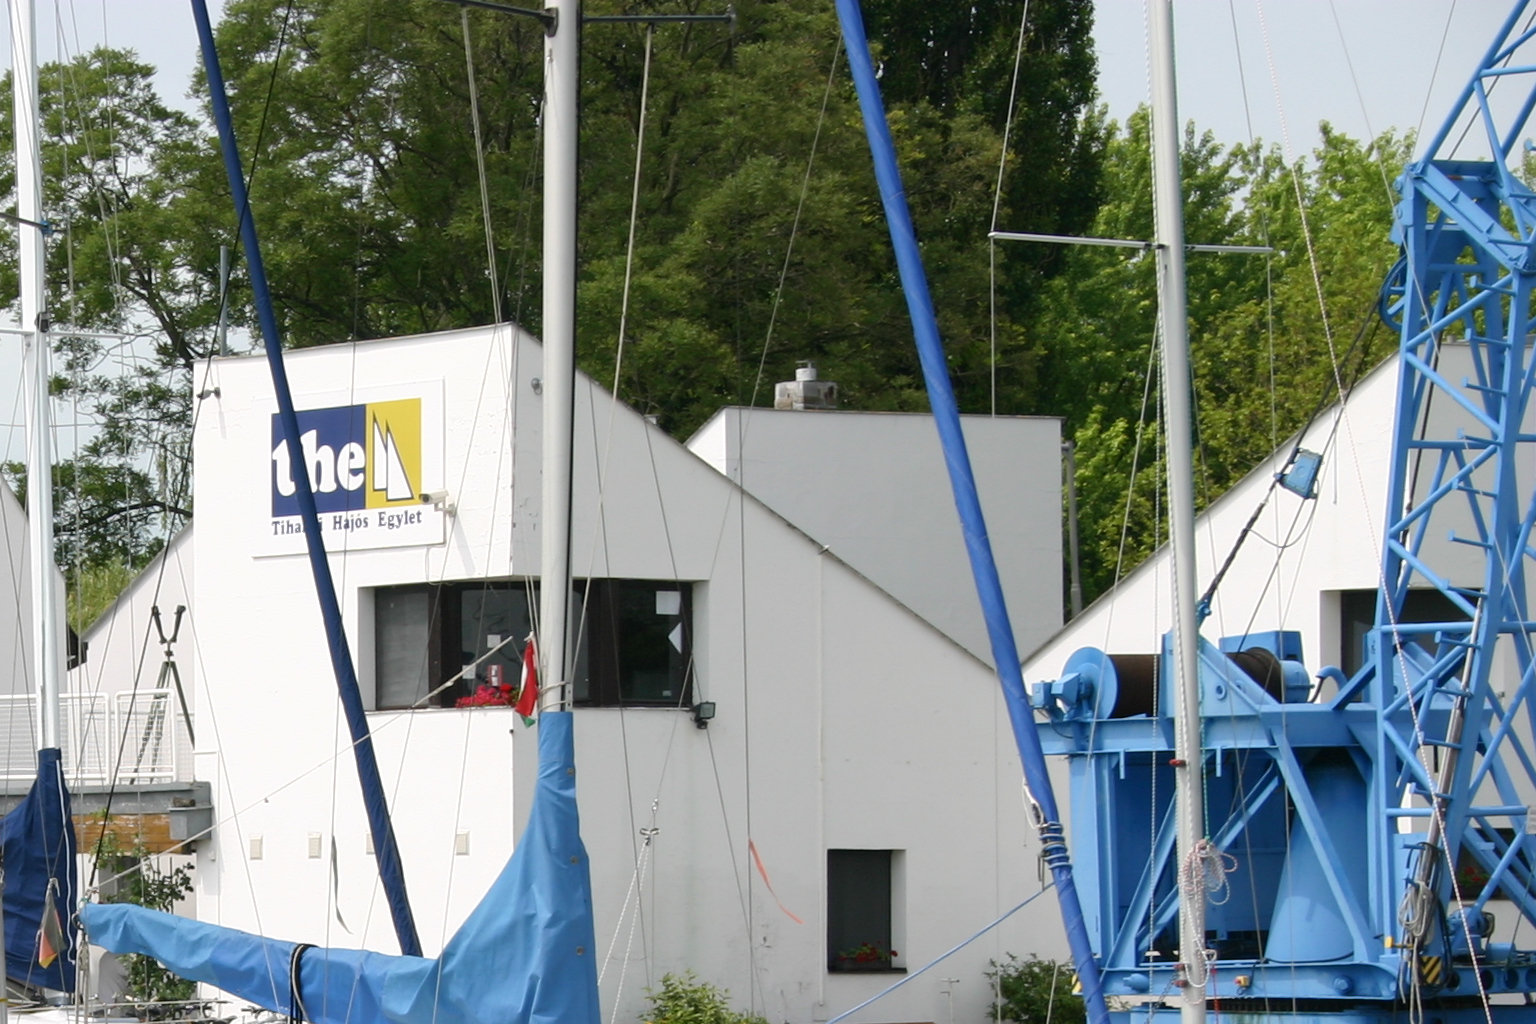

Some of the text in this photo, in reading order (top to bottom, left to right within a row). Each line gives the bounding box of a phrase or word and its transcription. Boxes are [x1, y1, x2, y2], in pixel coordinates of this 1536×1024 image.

[272, 429, 366, 497] the
[272, 508, 422, 535] Tihai Hajós Egylet
